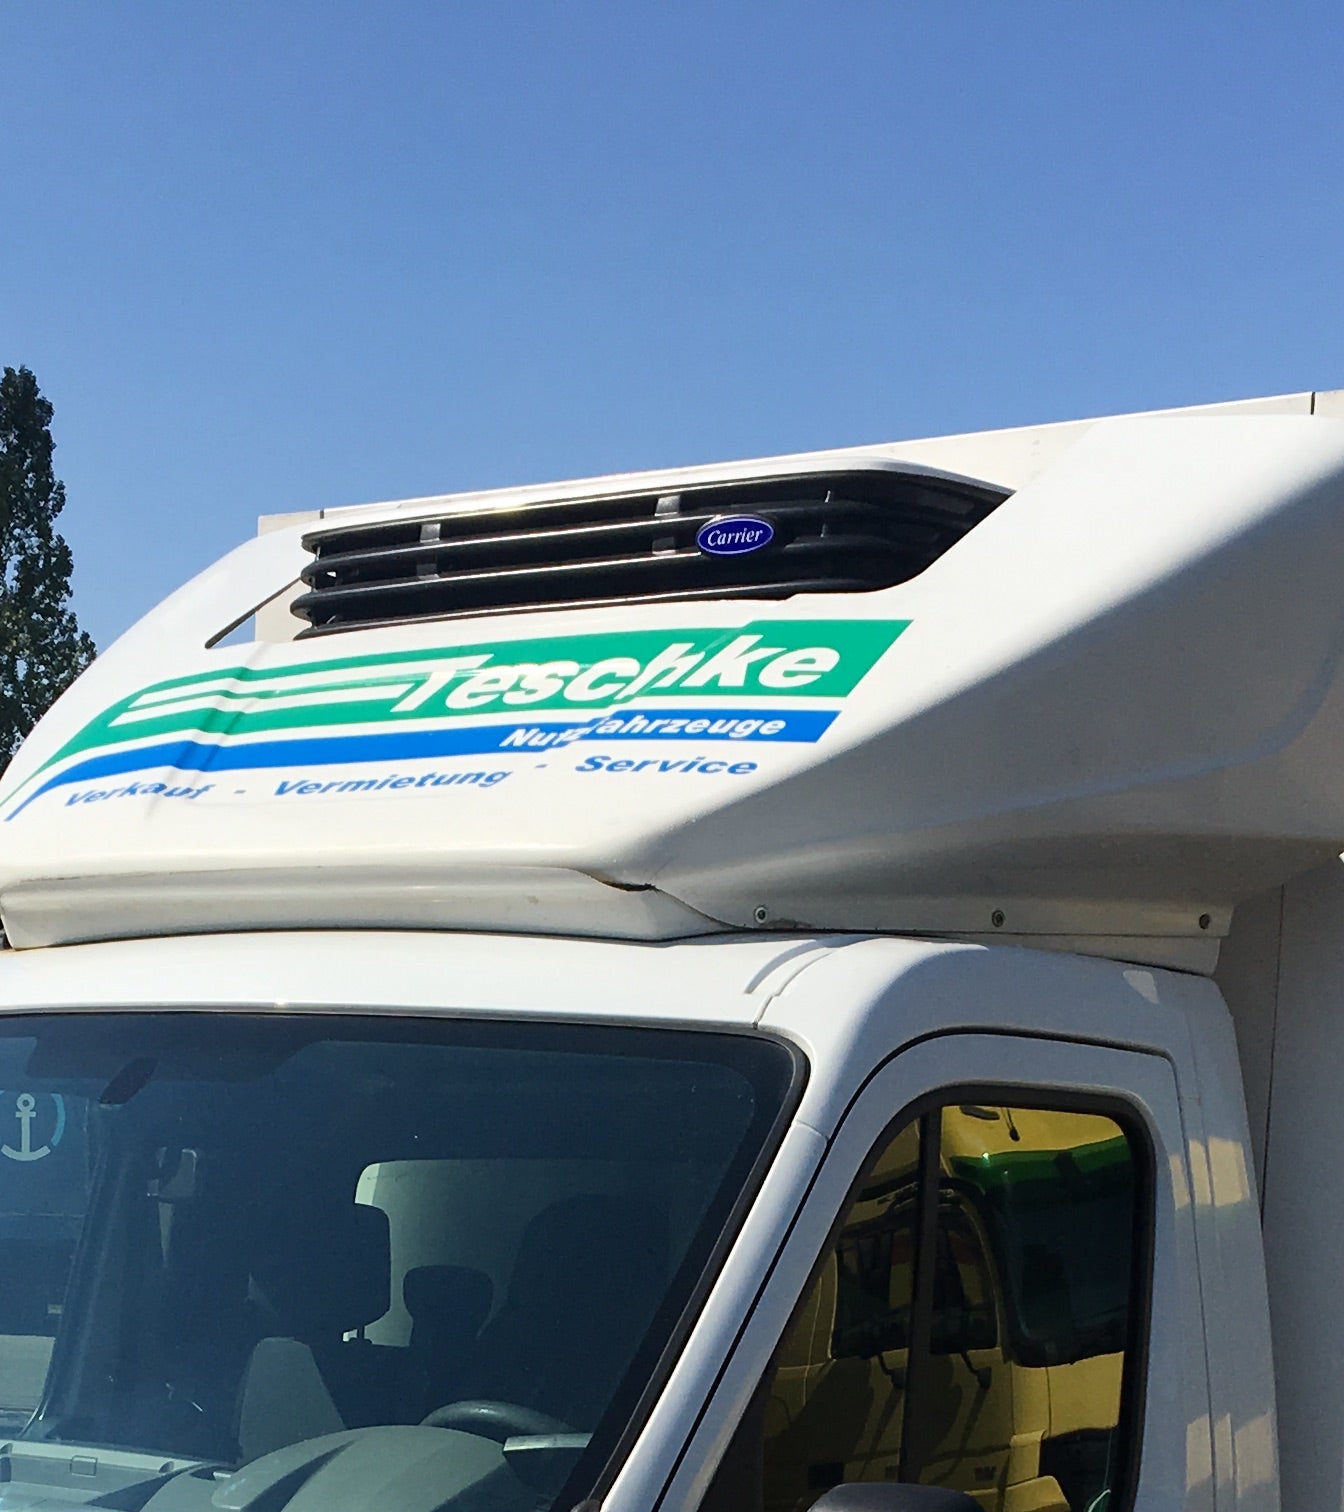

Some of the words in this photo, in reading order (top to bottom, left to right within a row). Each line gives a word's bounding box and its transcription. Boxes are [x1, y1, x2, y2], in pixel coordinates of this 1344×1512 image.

[707, 527, 764, 547] Carrier
[389, 633, 841, 714] Teschke
[63, 781, 217, 808] Verkauf
[273, 769, 514, 797] Vermietung
[574, 754, 759, 776] Service
